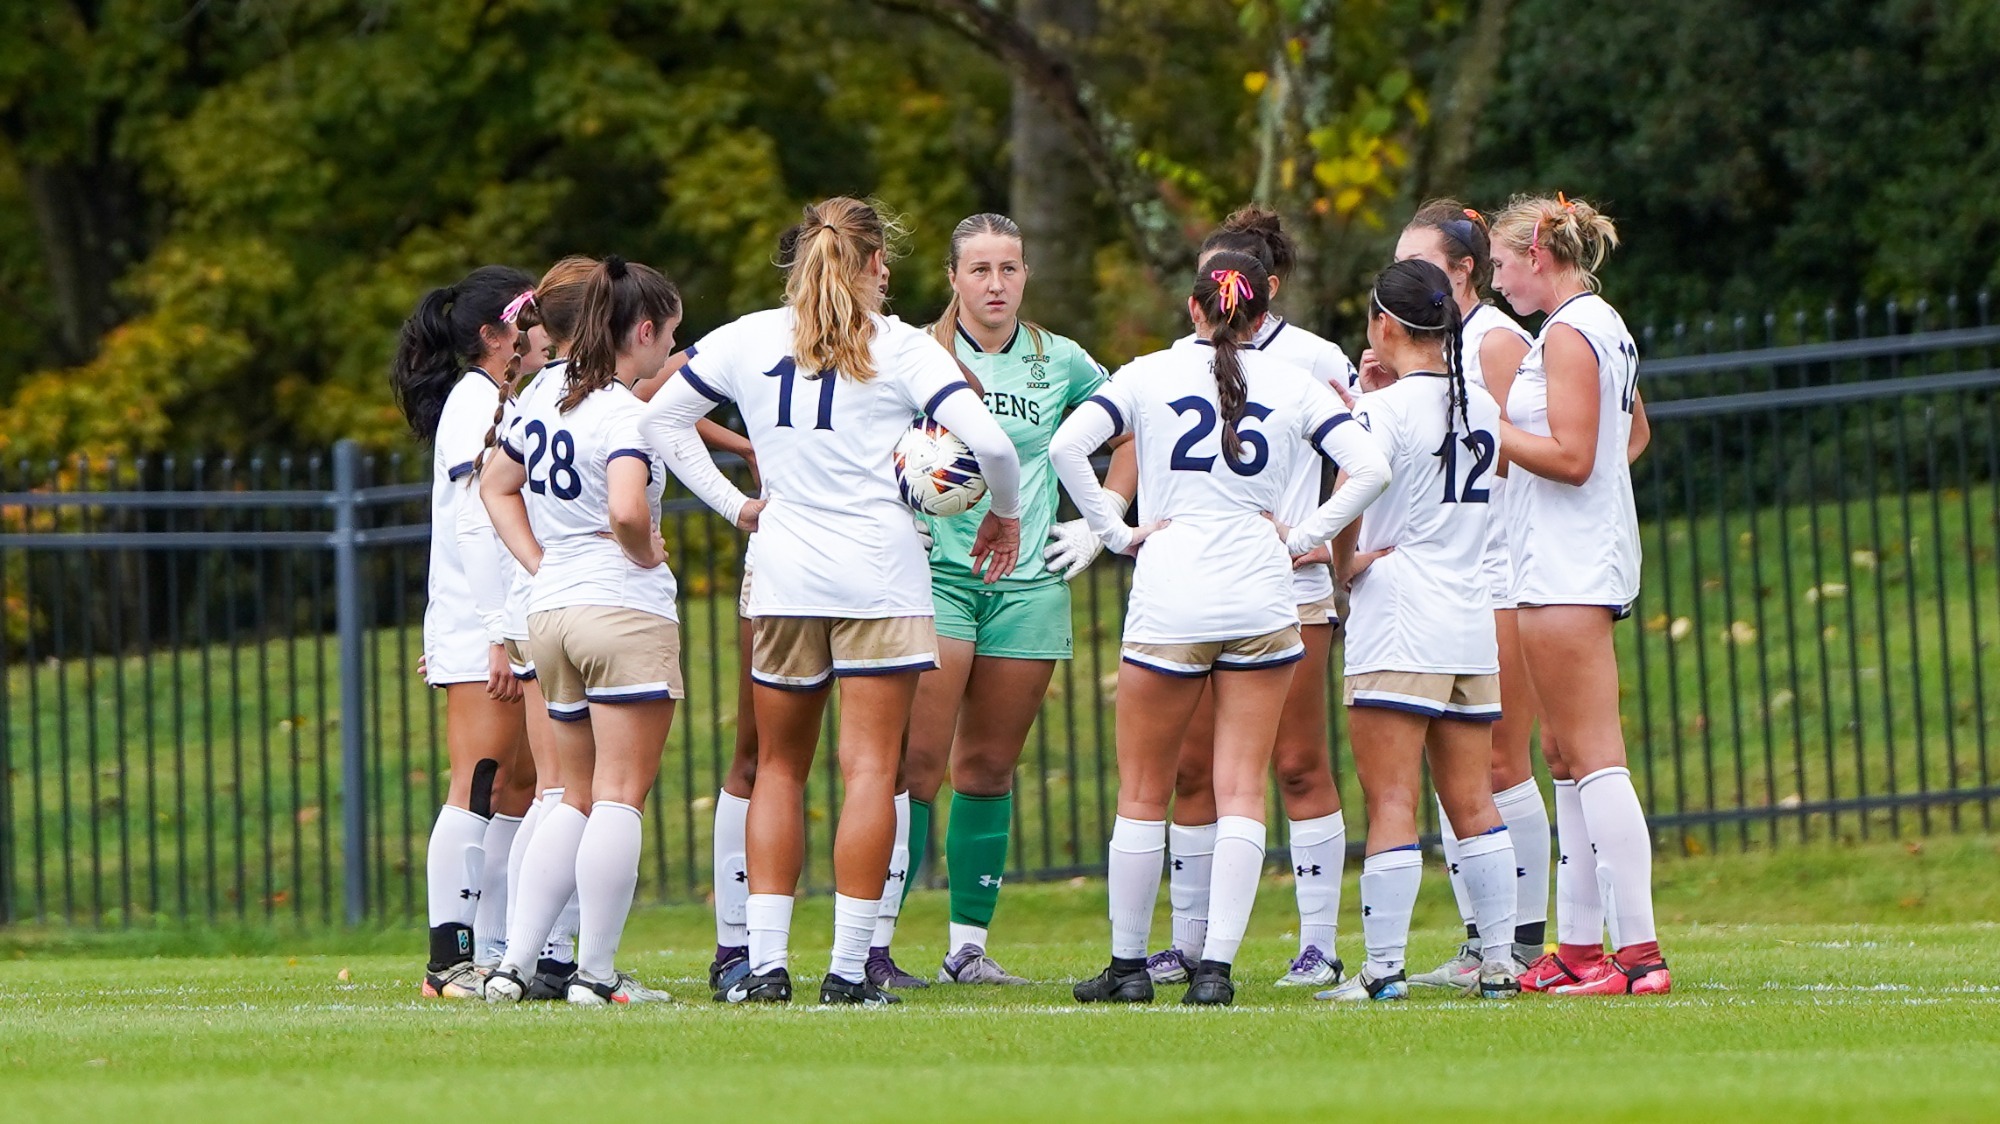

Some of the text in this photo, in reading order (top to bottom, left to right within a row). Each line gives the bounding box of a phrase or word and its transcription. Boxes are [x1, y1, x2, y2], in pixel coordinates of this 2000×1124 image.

[762, 355, 835, 432] 11
[525, 419, 582, 500] 28
[1166, 395, 1275, 477] 26
[1432, 429, 1495, 504] 12
